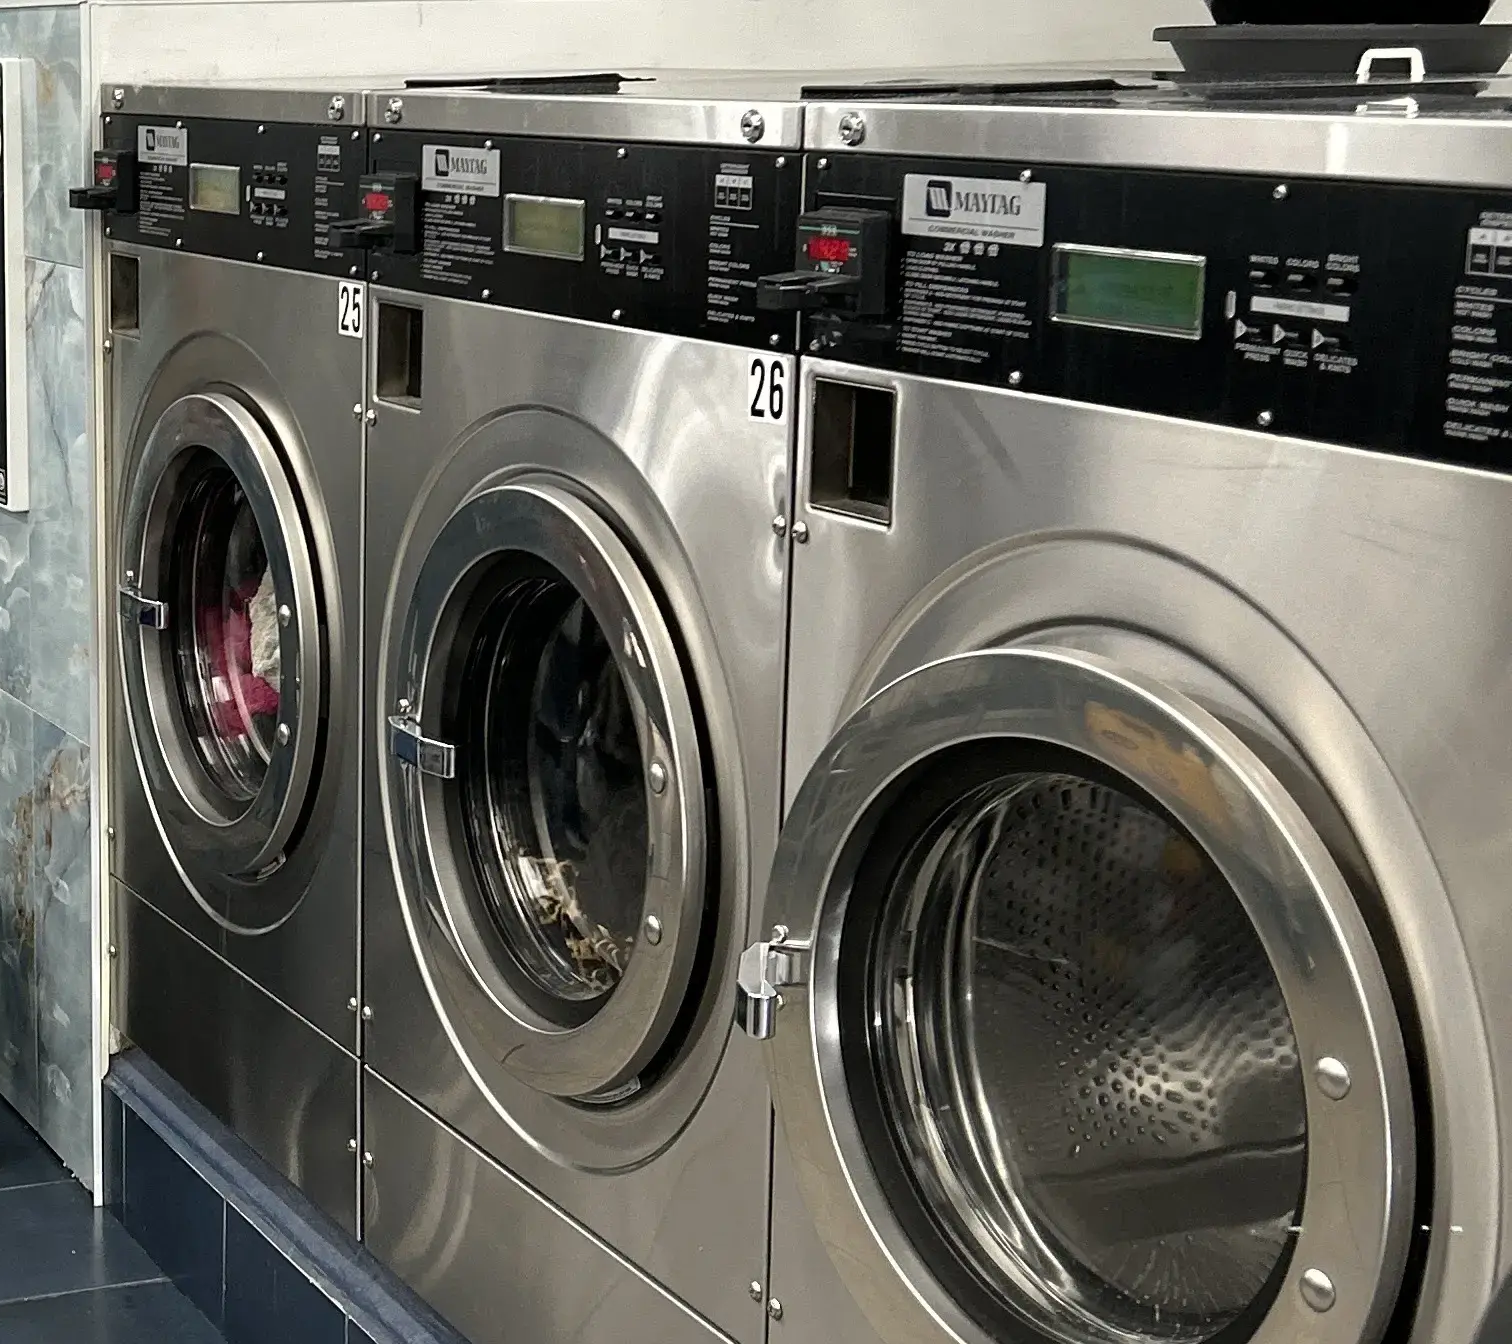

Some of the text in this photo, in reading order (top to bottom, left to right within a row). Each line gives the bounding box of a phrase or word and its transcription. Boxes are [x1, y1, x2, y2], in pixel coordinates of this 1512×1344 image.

[450, 156, 488, 175] MAYTAG
[954, 191, 1022, 216] MAYTAG
[340, 285, 361, 333] 25
[750, 358, 784, 421] 26
